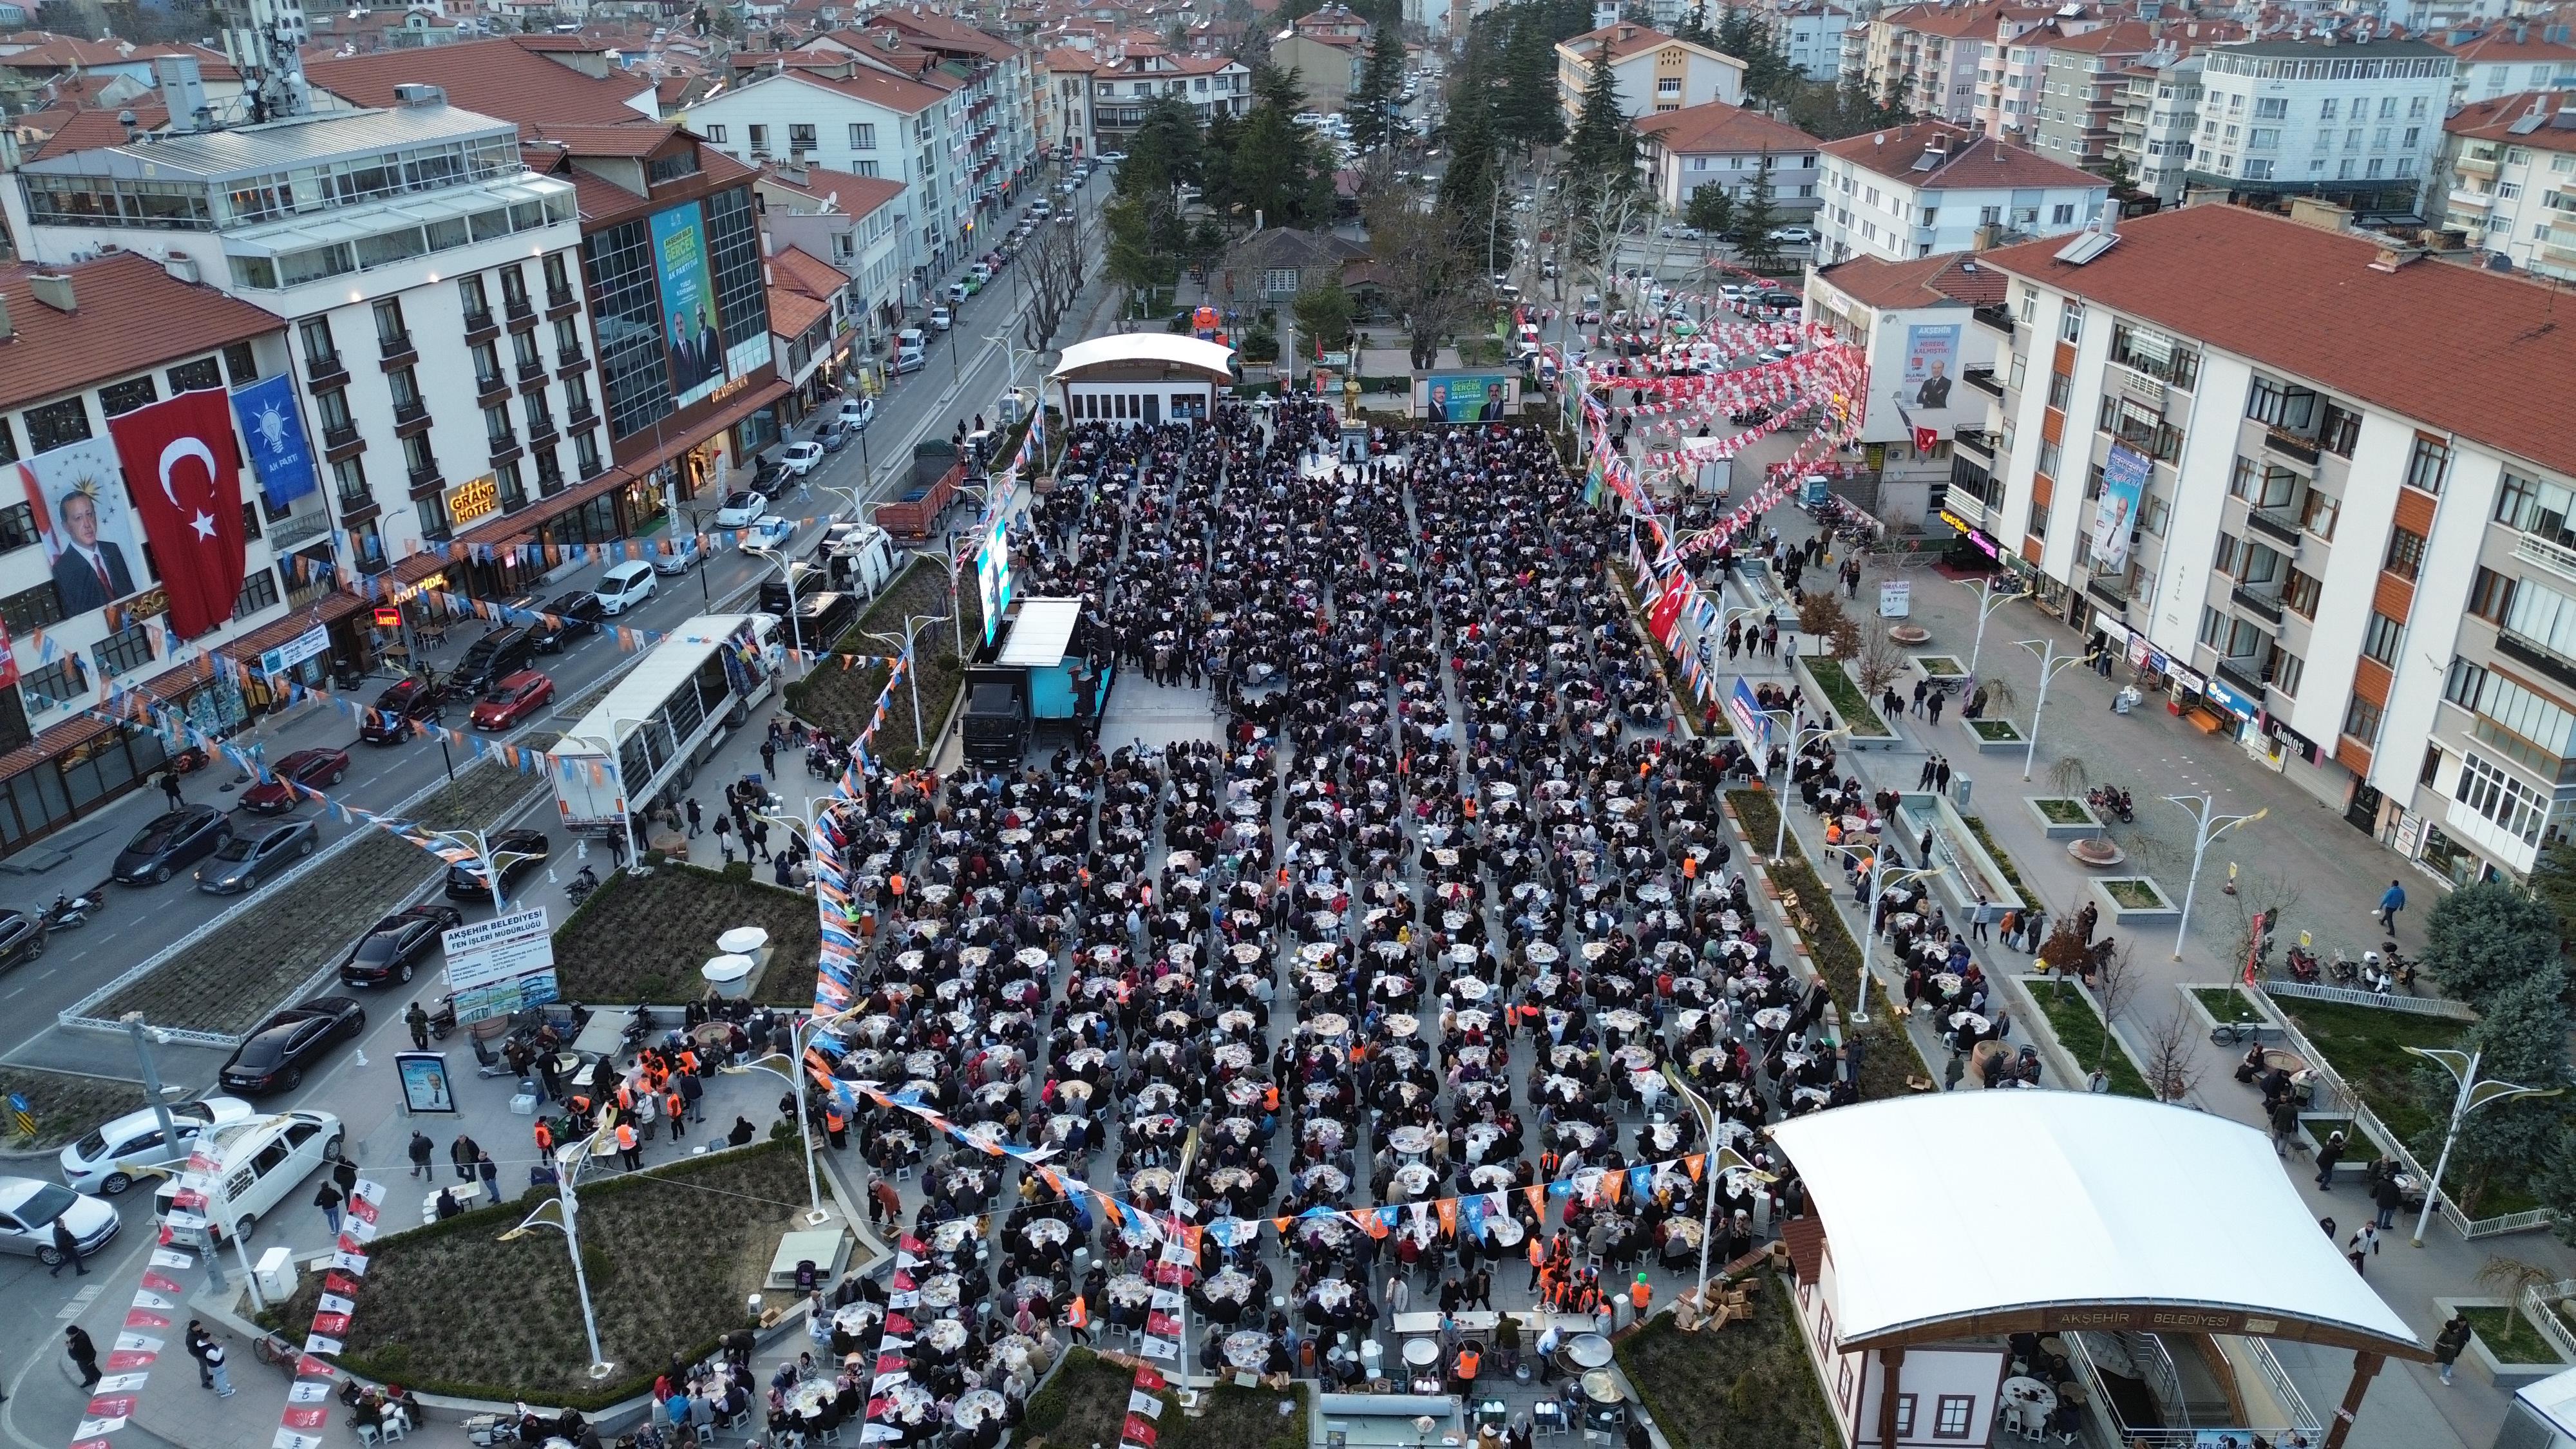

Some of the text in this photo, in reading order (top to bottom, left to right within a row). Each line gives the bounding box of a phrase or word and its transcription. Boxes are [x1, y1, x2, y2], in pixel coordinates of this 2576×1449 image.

[668, 271, 676, 281] AK
[1918, 326, 1951, 334] AKŞEHİR
[270, 462, 279, 473] AK
[450, 482, 497, 511] GRAND
[456, 498, 496, 524] HOTEL
[448, 909, 542, 941] AKŞEHİR BELEDİYESİ
[452, 921, 542, 950] FEN İŞLERİ MÜDÜRLÜĞÜ
[334, 1318, 345, 1332] CHP
[2060, 1312, 2129, 1325] AKŞEHİR
[2154, 1312, 2230, 1327] BELEDİYESİ
[308, 1410, 319, 1426] CHP
